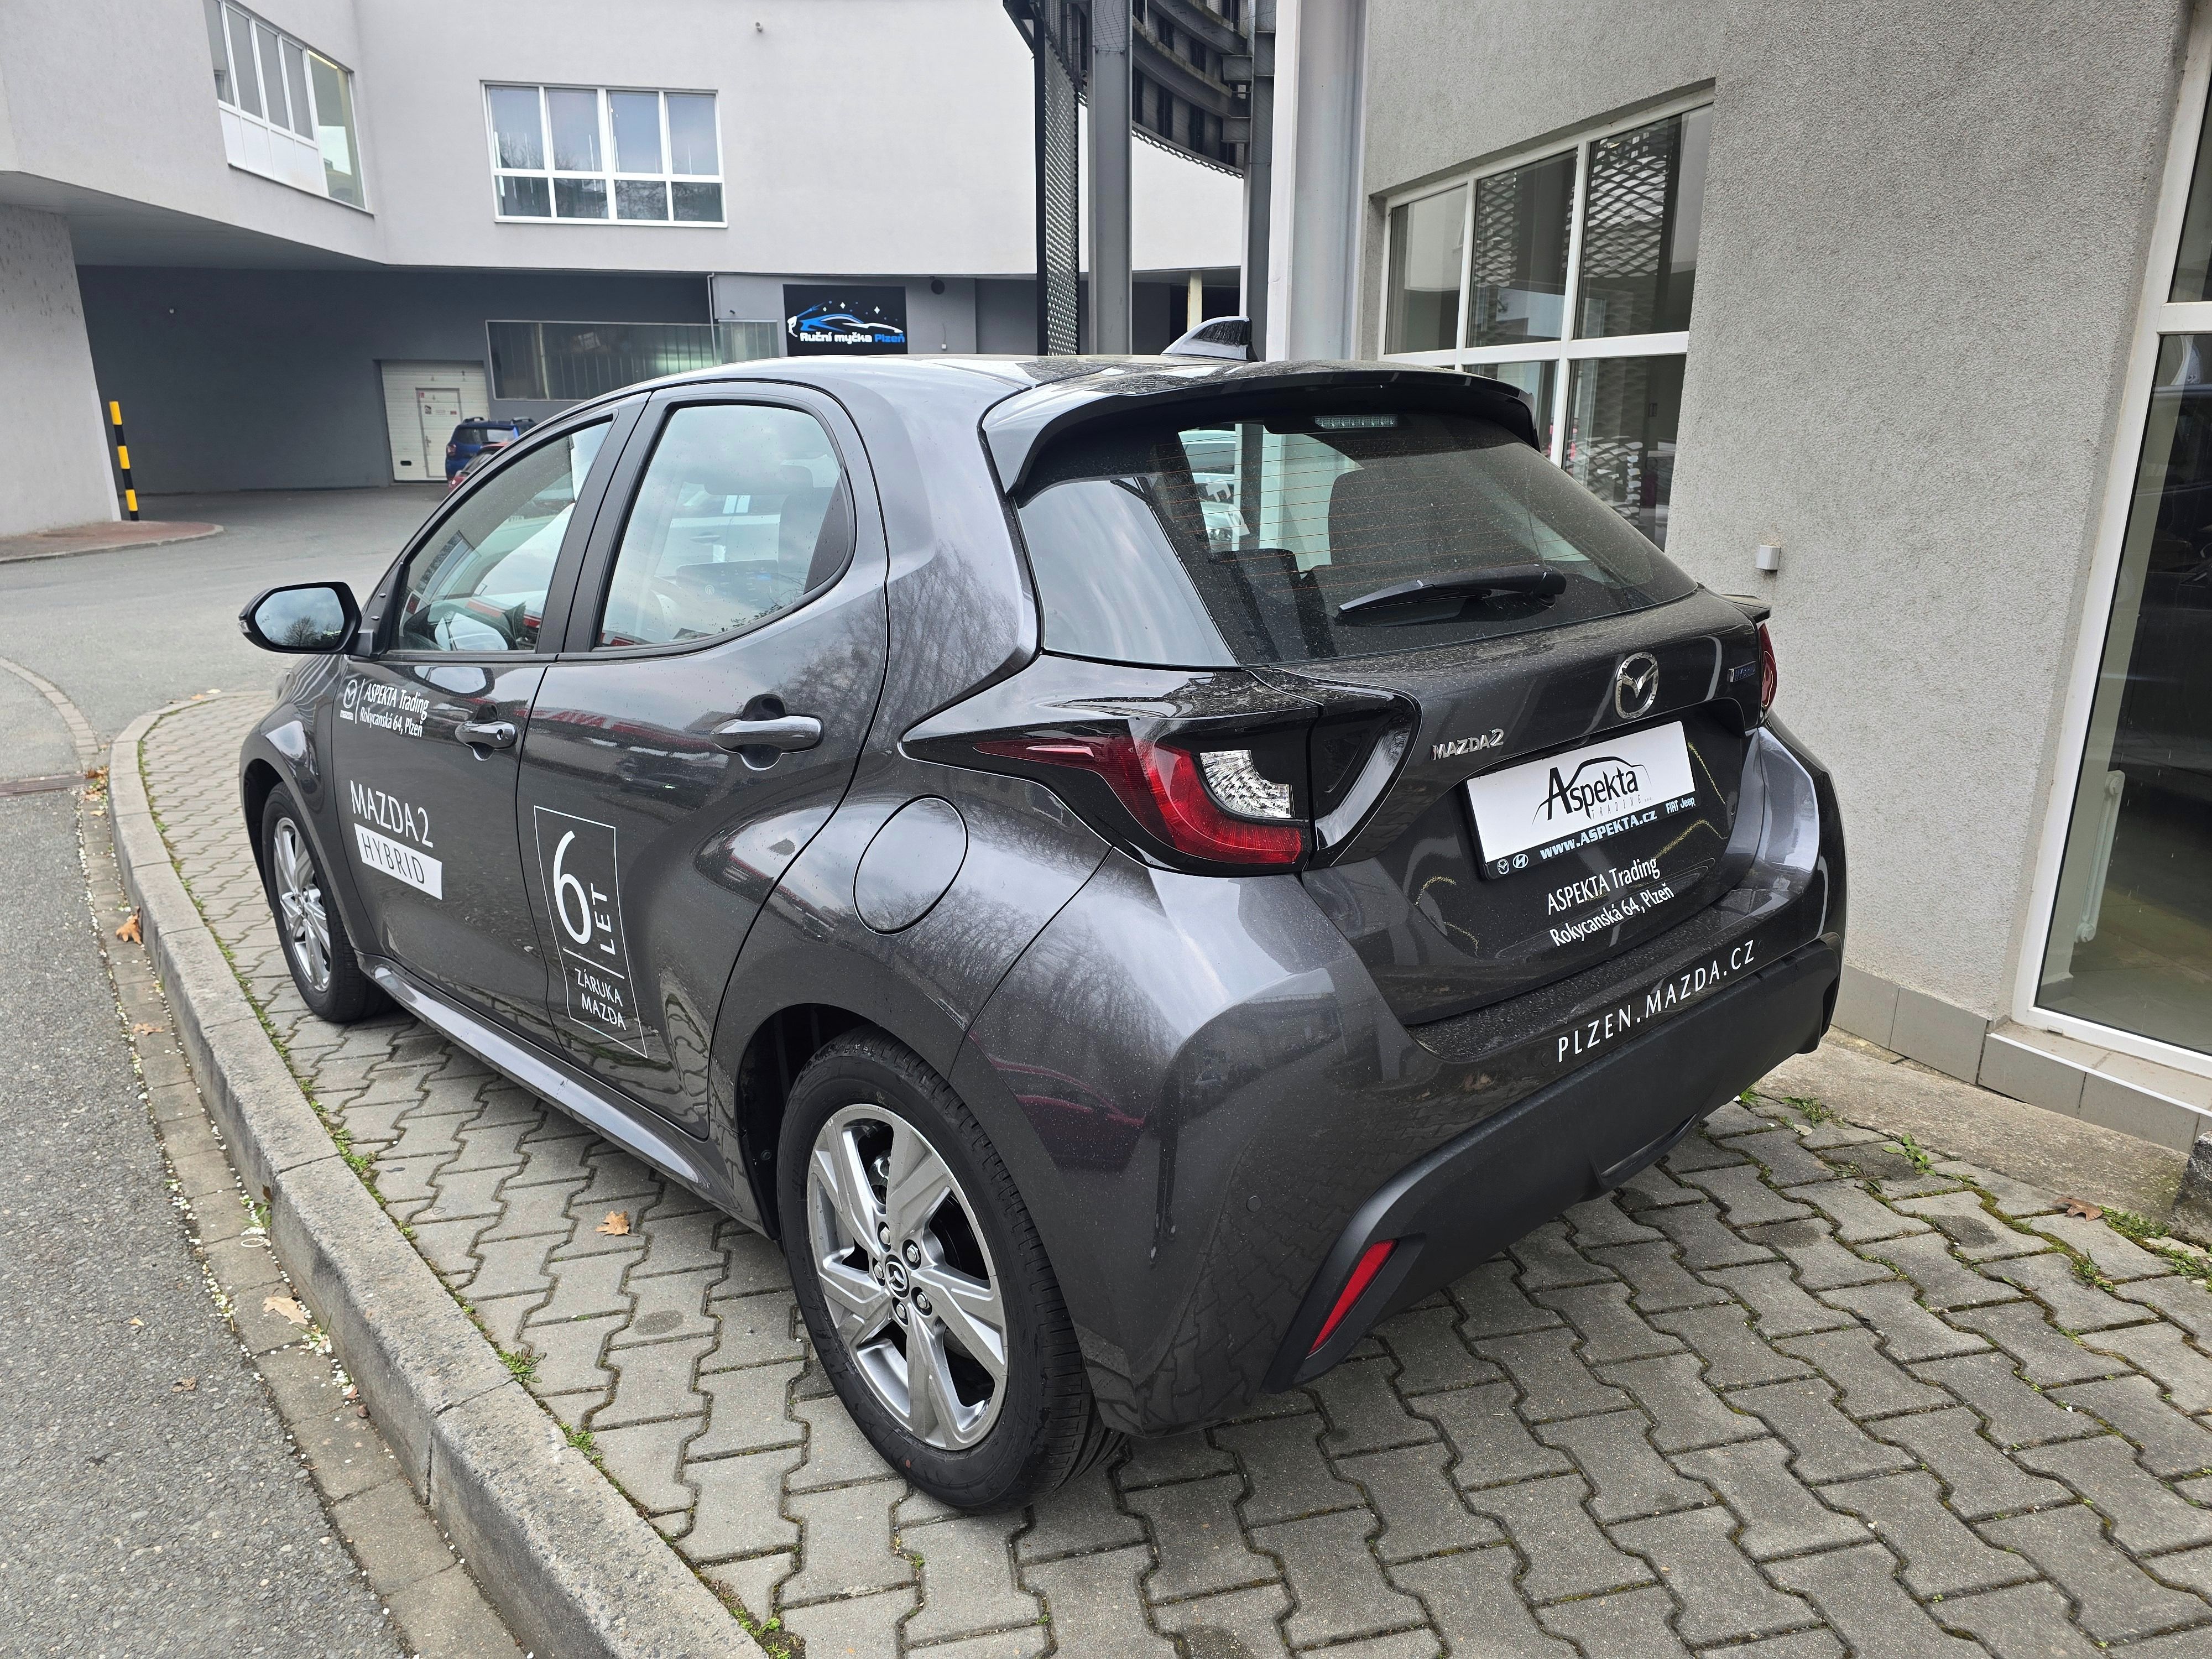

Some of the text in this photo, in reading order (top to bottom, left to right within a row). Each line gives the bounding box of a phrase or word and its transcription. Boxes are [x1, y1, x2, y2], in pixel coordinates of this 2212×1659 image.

[800, 331, 905, 344] Ruční myčka Plzeň
[363, 683, 430, 721] ASPEKTA Trading
[360, 707, 392, 729] Rokycanská
[393, 714, 404, 735] 64,
[405, 721, 423, 738] Plzeň
[1430, 728, 1504, 761] MAZDA2
[1547, 766, 1639, 821] Aspekta
[1592, 794, 1641, 820] TRADING
[1665, 800, 1679, 814] FIAT
[1680, 797, 1696, 808] Jeep
[361, 833, 425, 884] HYBRID
[553, 830, 592, 945] 6
[1547, 857, 1660, 915] ASPEKTA Trading
[590, 883, 615, 955] LET
[1550, 883, 1674, 947] Rokycanská 64, Plzeň
[575, 968, 623, 1007] ZÁRUKA
[1558, 940, 1755, 1063] PLZEN.MAZDA.CZ
[581, 993, 627, 1031] MAZDA
